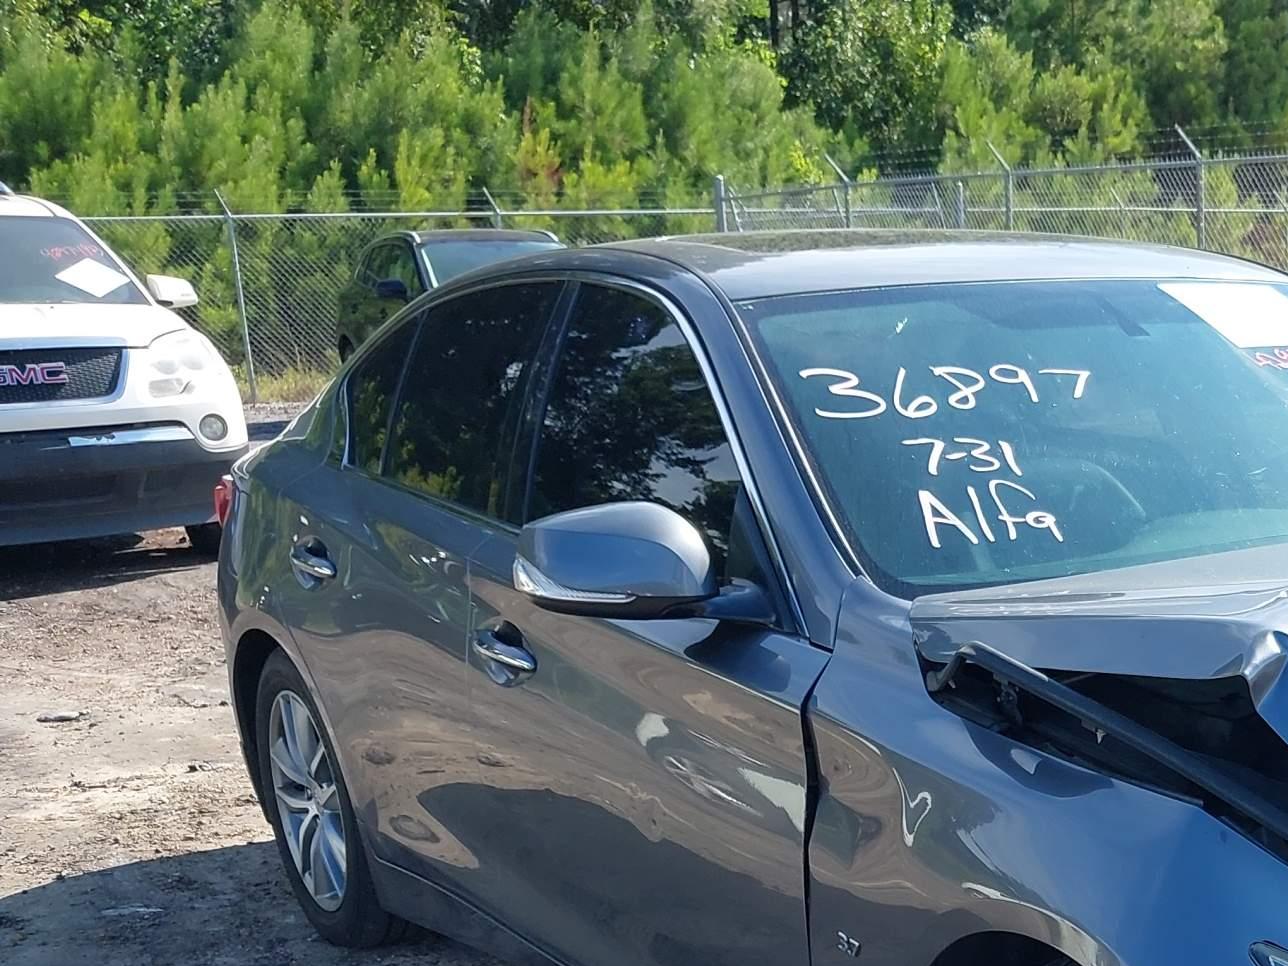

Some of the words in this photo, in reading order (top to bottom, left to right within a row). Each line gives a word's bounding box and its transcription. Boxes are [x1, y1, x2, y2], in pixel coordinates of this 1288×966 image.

[799, 363, 1091, 419] 36897
[901, 437, 1023, 476] 7-31
[918, 479, 1064, 548] Alfa
